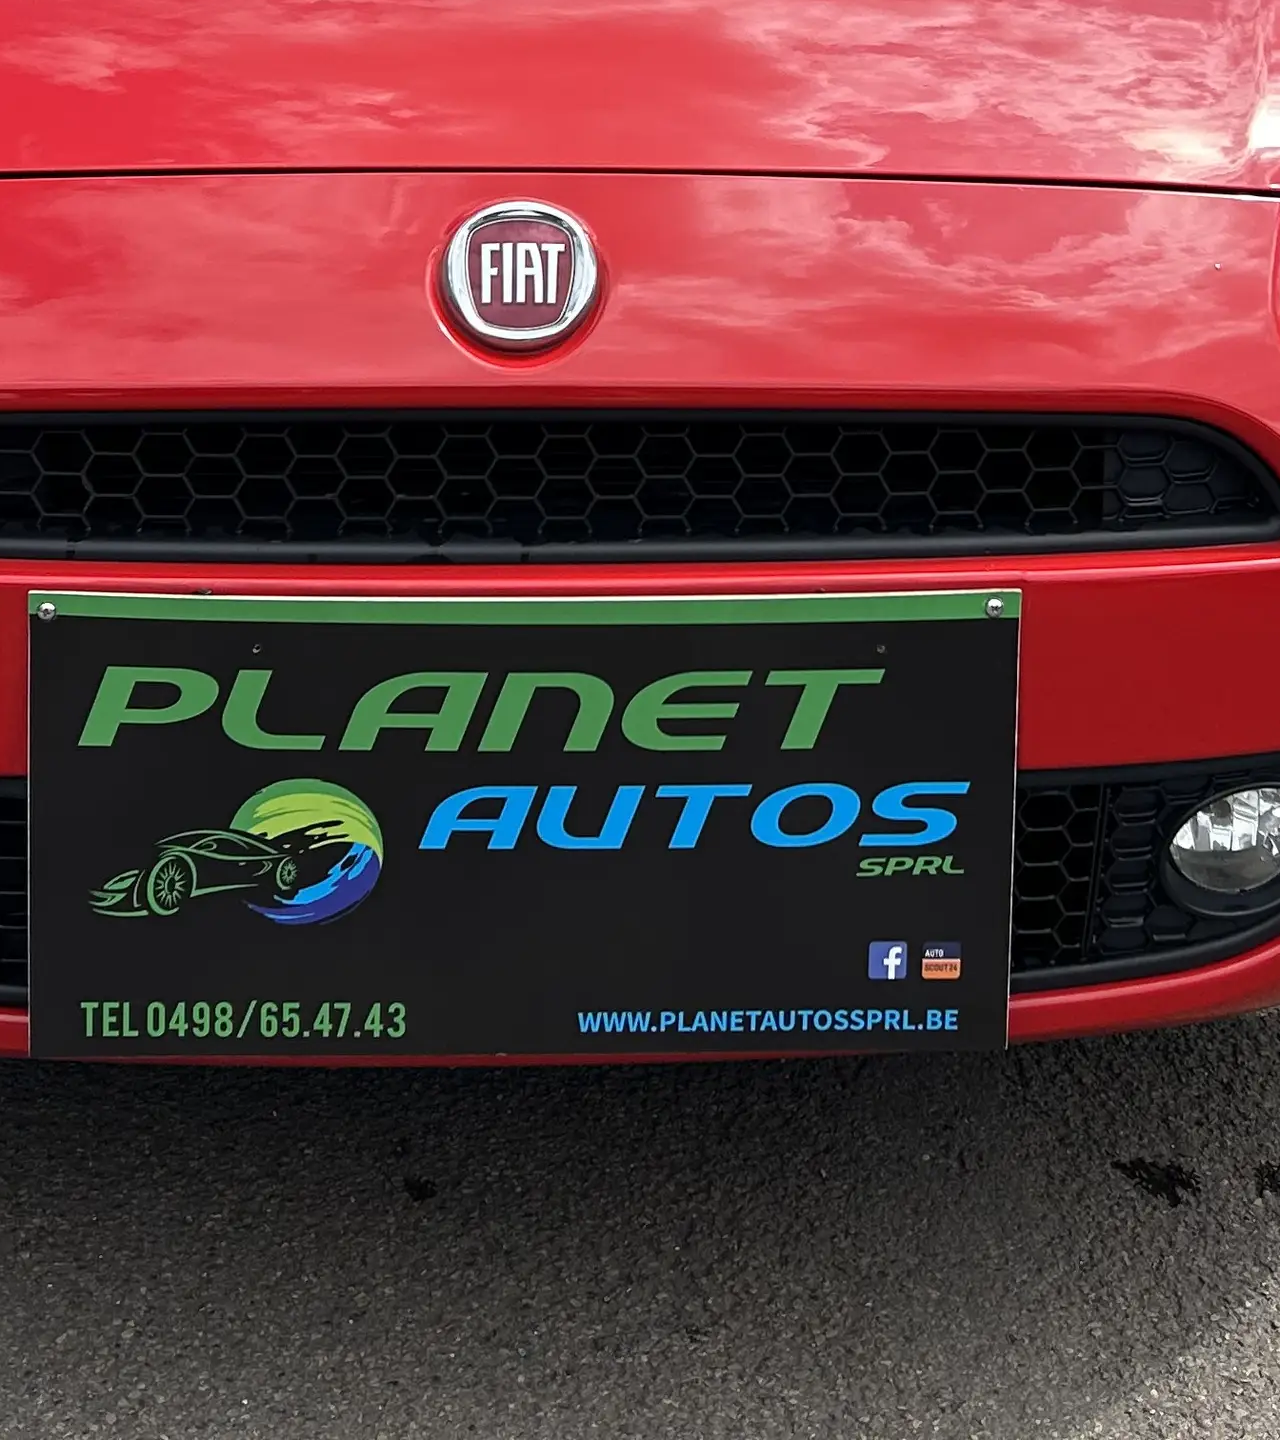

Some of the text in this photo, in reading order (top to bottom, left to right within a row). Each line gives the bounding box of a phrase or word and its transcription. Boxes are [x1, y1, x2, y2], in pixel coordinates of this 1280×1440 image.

[480, 242, 566, 305] FIAT
[77, 665, 887, 752] PLANET
[418, 781, 971, 850] AUTOS
[856, 855, 964, 877] SPRL
[924, 948, 944, 958] AUTO
[80, 1000, 407, 1039] TEL 0498/65.47.43
[577, 1009, 959, 1034] WWW.PLANETAUTOSSPRL.BE
